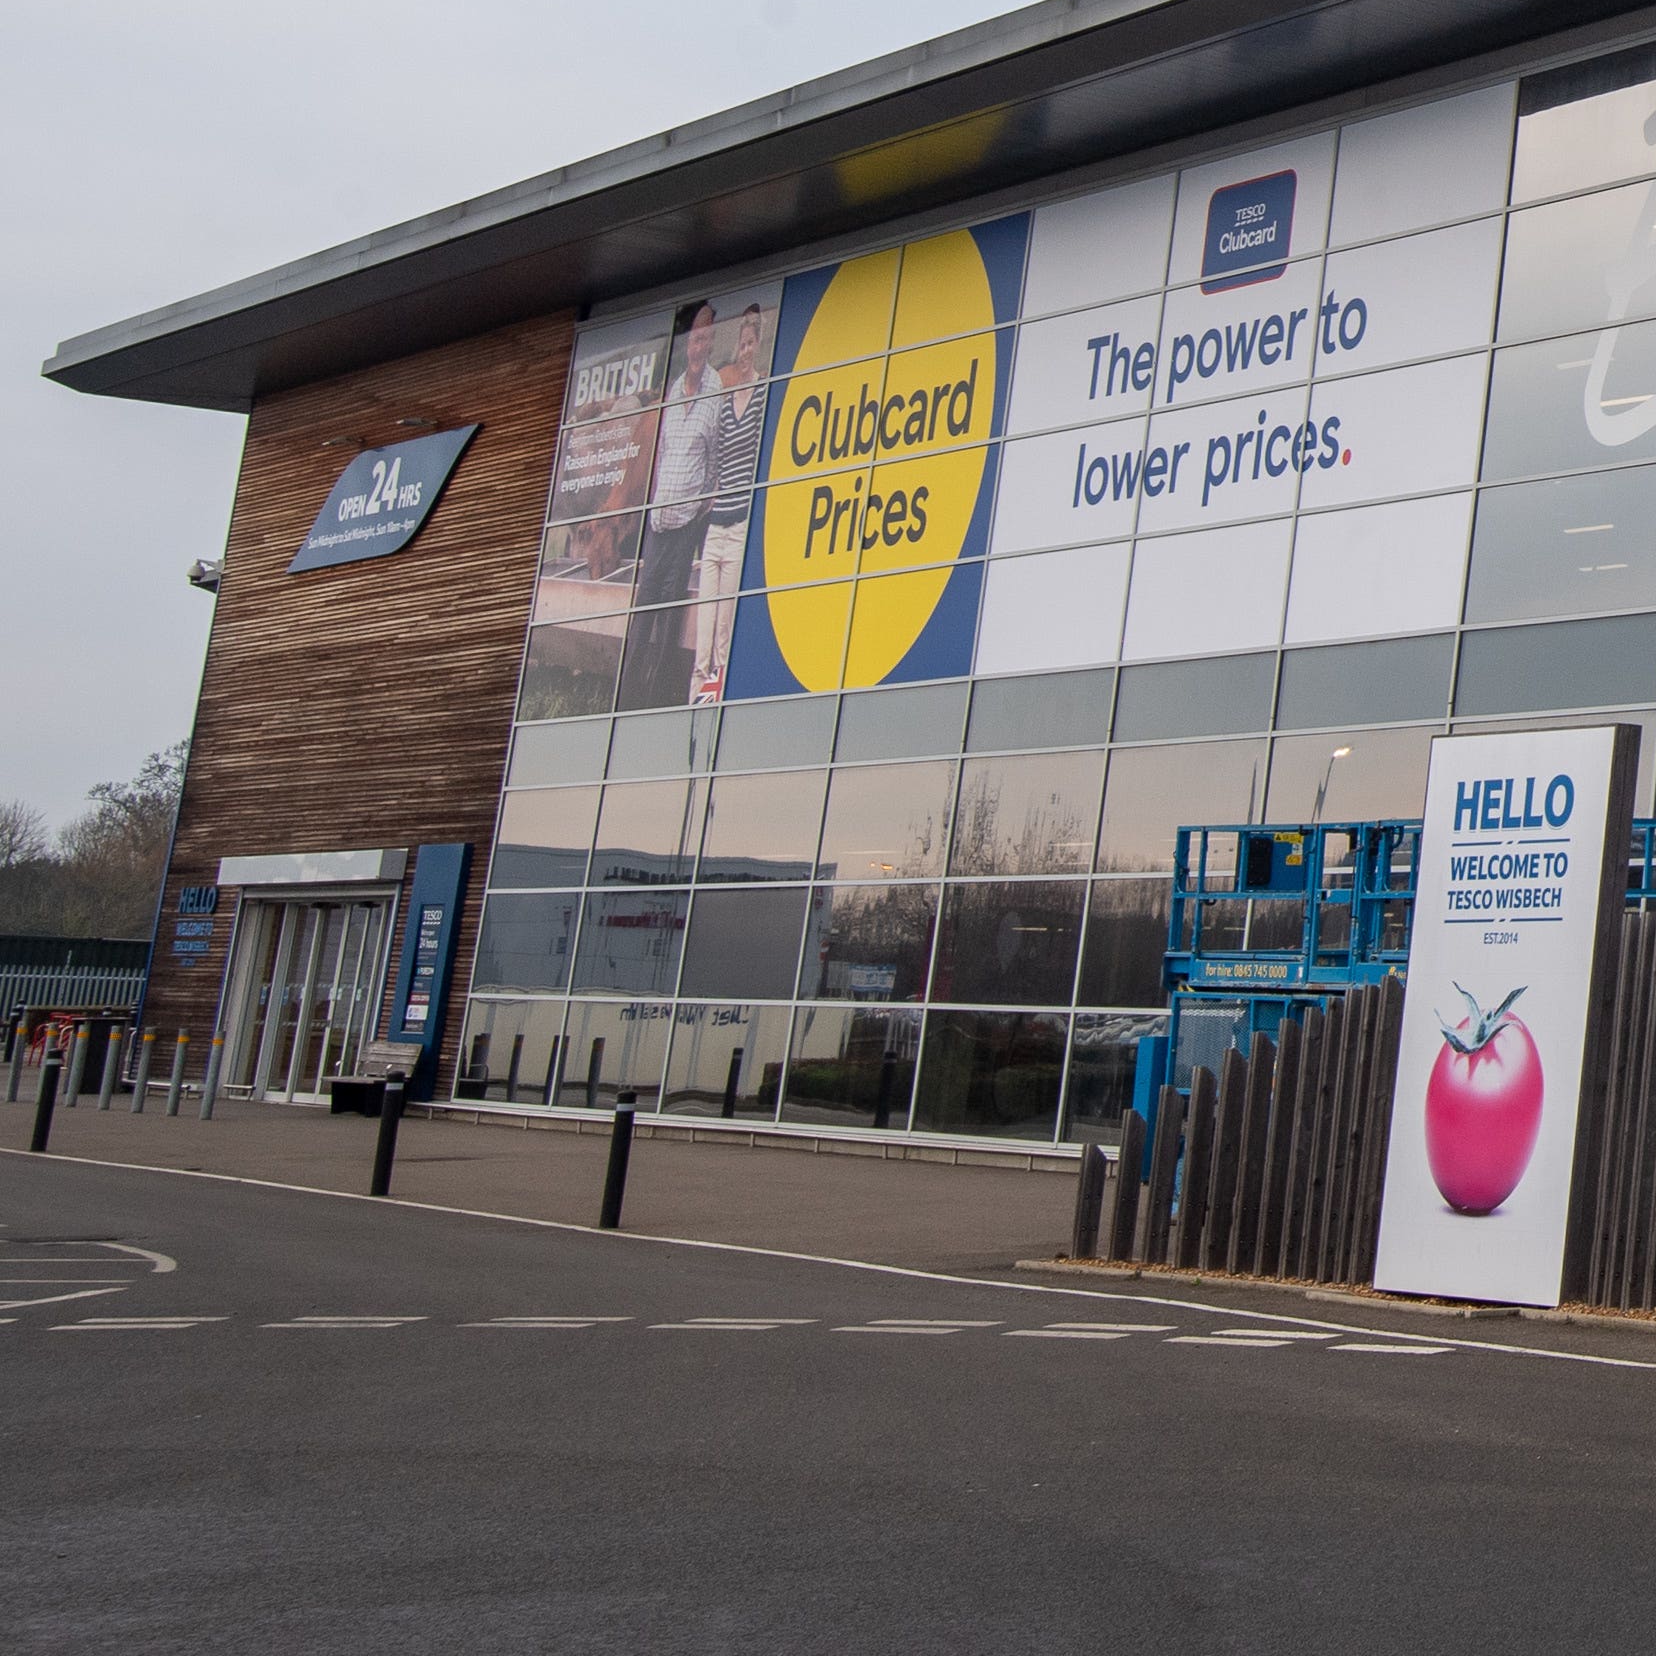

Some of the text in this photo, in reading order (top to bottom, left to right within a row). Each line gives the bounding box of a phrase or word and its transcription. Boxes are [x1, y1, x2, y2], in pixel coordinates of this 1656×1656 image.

[1235, 204, 1265, 221] TESCO
[1220, 220, 1277, 254] Clubcard
[1087, 289, 1368, 404] The power to
[574, 352, 657, 407] BRITISH
[791, 358, 978, 467] Clubcard
[597, 443, 628, 467] England
[628, 442, 640, 459] for
[1072, 409, 1352, 508] lower prices.
[338, 457, 423, 522] OPEN 24 HRS
[805, 476, 929, 558] Prices
[1454, 774, 1574, 831] HELLO
[1451, 852, 1568, 880] WELCOME TO
[180, 887, 218, 914] HELLO
[423, 910, 442, 921] TESCO
[1448, 887, 1562, 910] TESCO WISBECH
[1205, 962, 1216, 976] for
